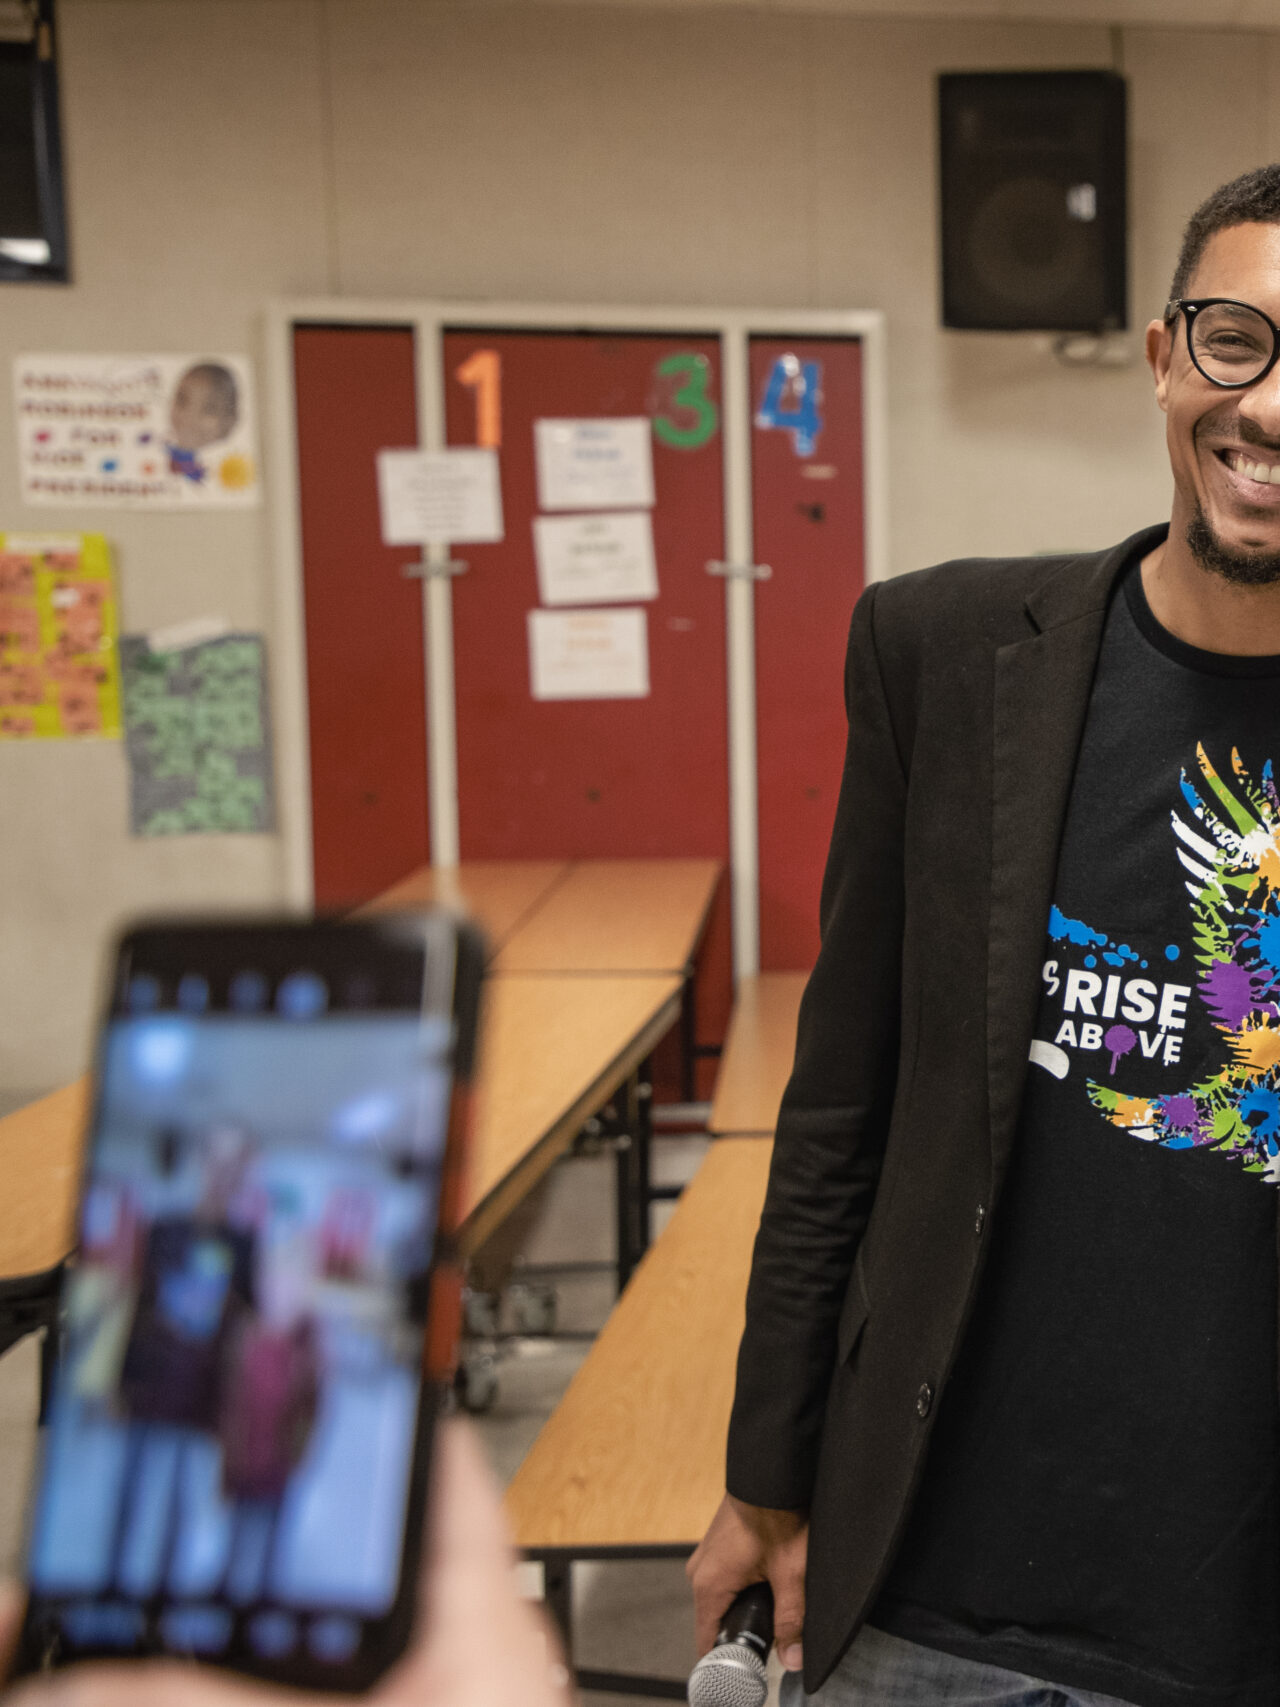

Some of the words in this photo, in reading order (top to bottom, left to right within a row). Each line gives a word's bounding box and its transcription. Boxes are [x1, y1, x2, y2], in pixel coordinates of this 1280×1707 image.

[457, 349, 500, 449] 1
[653, 352, 717, 450] 3
[757, 353, 824, 457] 4
[1063, 968, 1192, 1034] RISE
